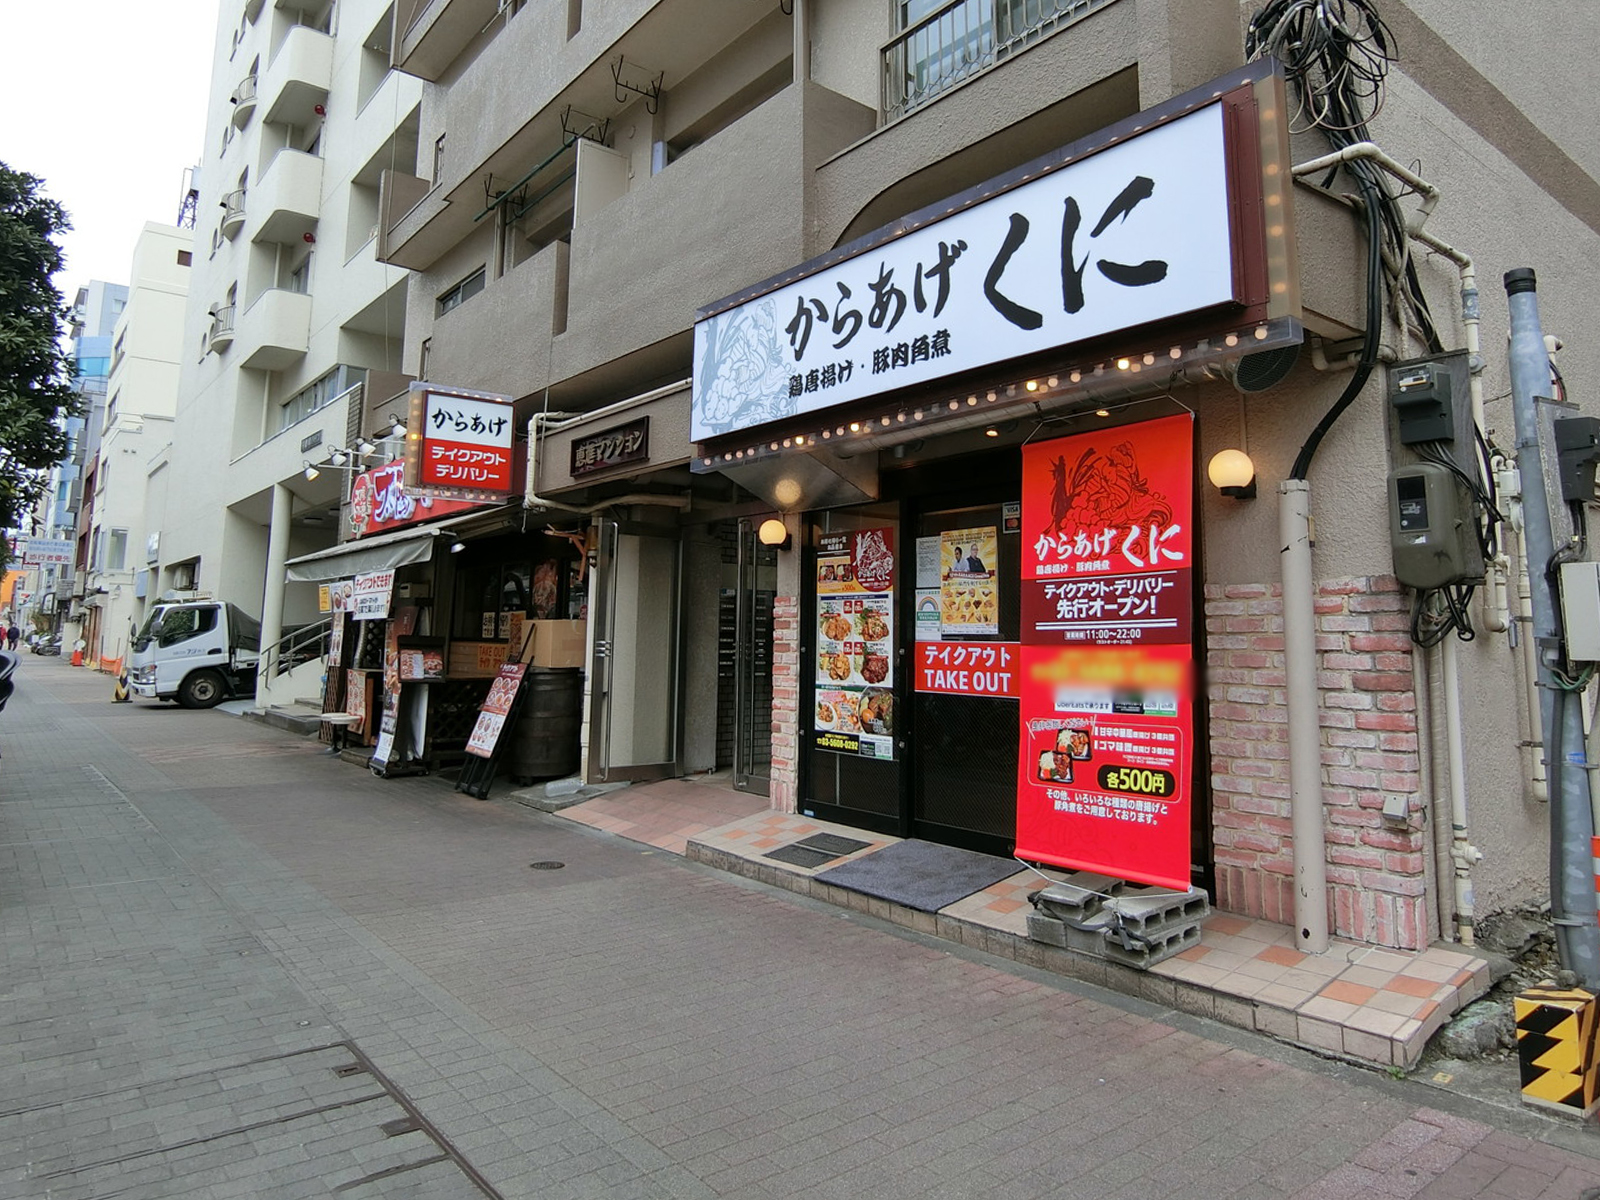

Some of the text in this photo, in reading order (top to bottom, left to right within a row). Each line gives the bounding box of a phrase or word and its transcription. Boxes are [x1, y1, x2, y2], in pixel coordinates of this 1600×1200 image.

[784, 176, 1168, 361] からあげ くに
[431, 407, 509, 437] からあげ
[431, 446, 507, 466] テイクアウト
[435, 464, 500, 482] デリバリー
[1033, 524, 1184, 567] からあげ くに
[1044, 577, 1174, 599] テイクアウト・デリバリー
[1056, 596, 1157, 619] 先行オープン!
[925, 646, 1011, 668] テイクアウト
[924, 669, 1011, 693] TAKE OUT
[1106, 768, 1165, 794] 各500円
